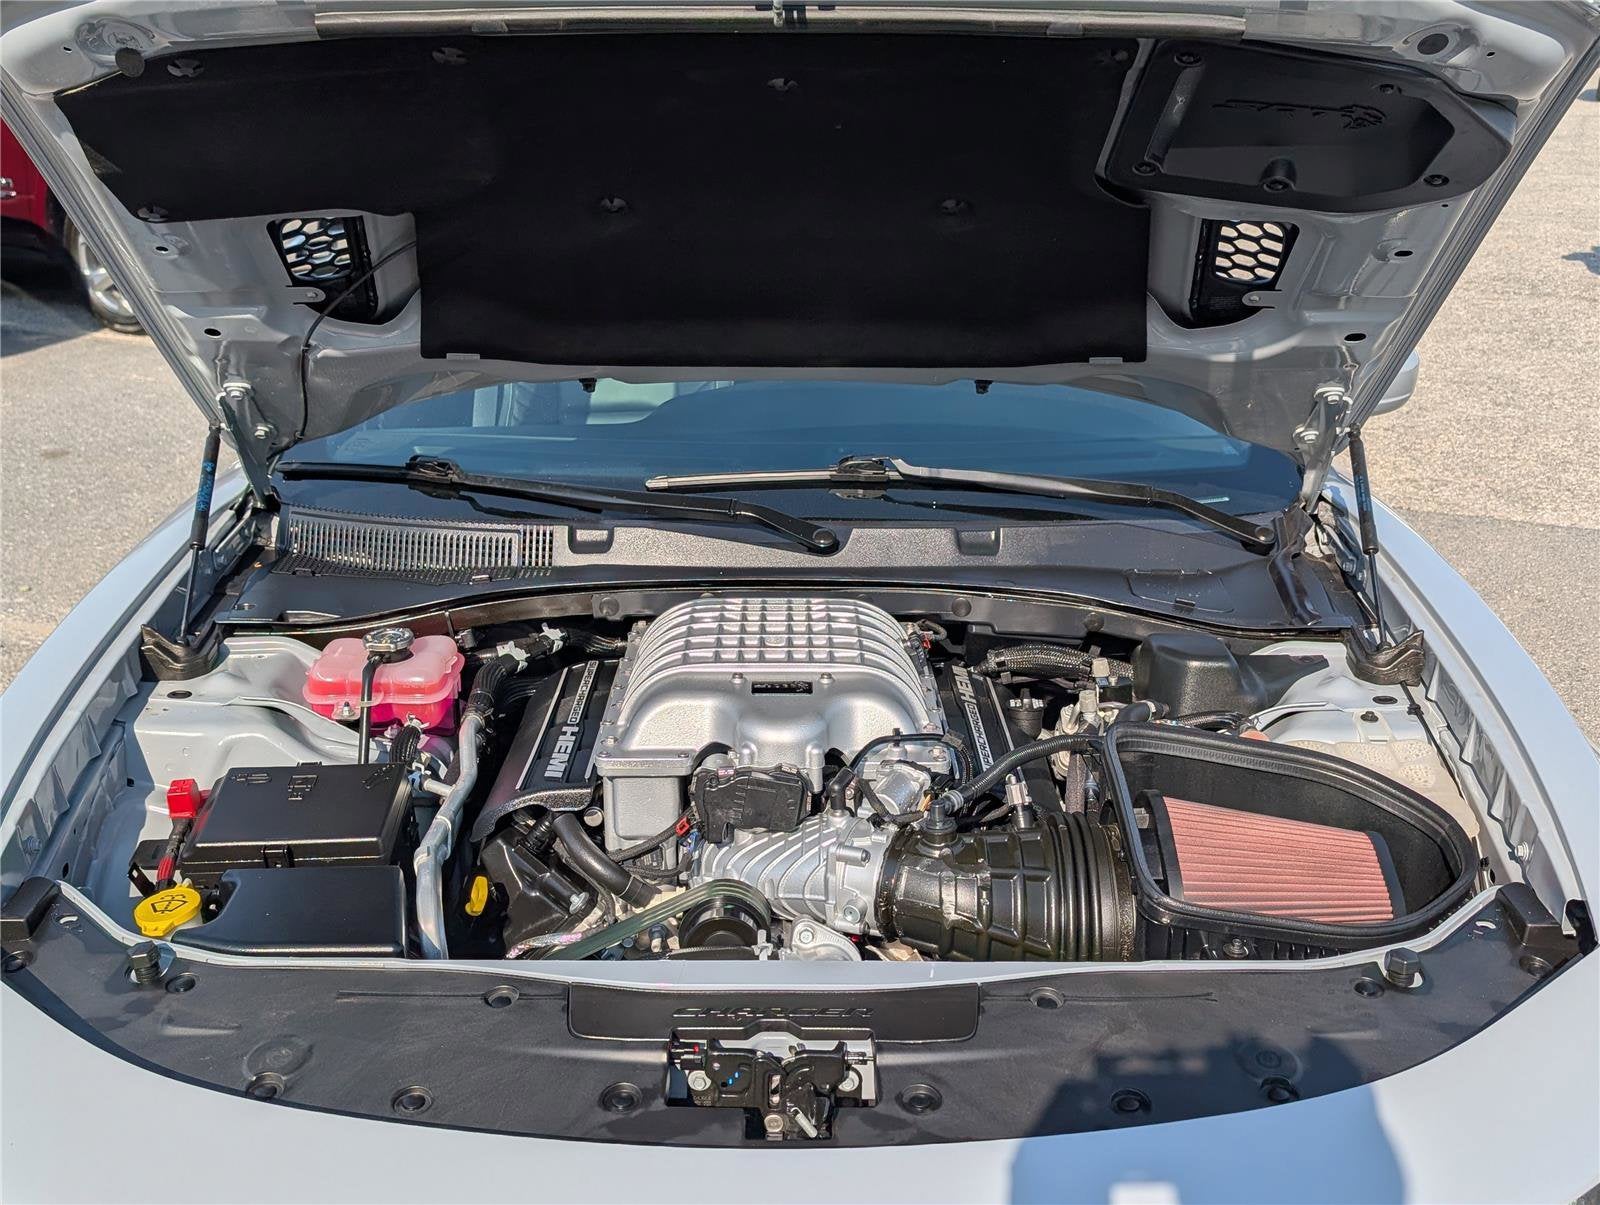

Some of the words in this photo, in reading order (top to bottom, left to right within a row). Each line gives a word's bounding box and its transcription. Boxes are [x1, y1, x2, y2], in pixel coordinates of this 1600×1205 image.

[568, 661, 598, 724] SUPERCHARGED
[544, 726, 579, 778] HEMI
[965, 703, 994, 769] PERCHARGED
[672, 1007, 874, 1018] CHARGER
